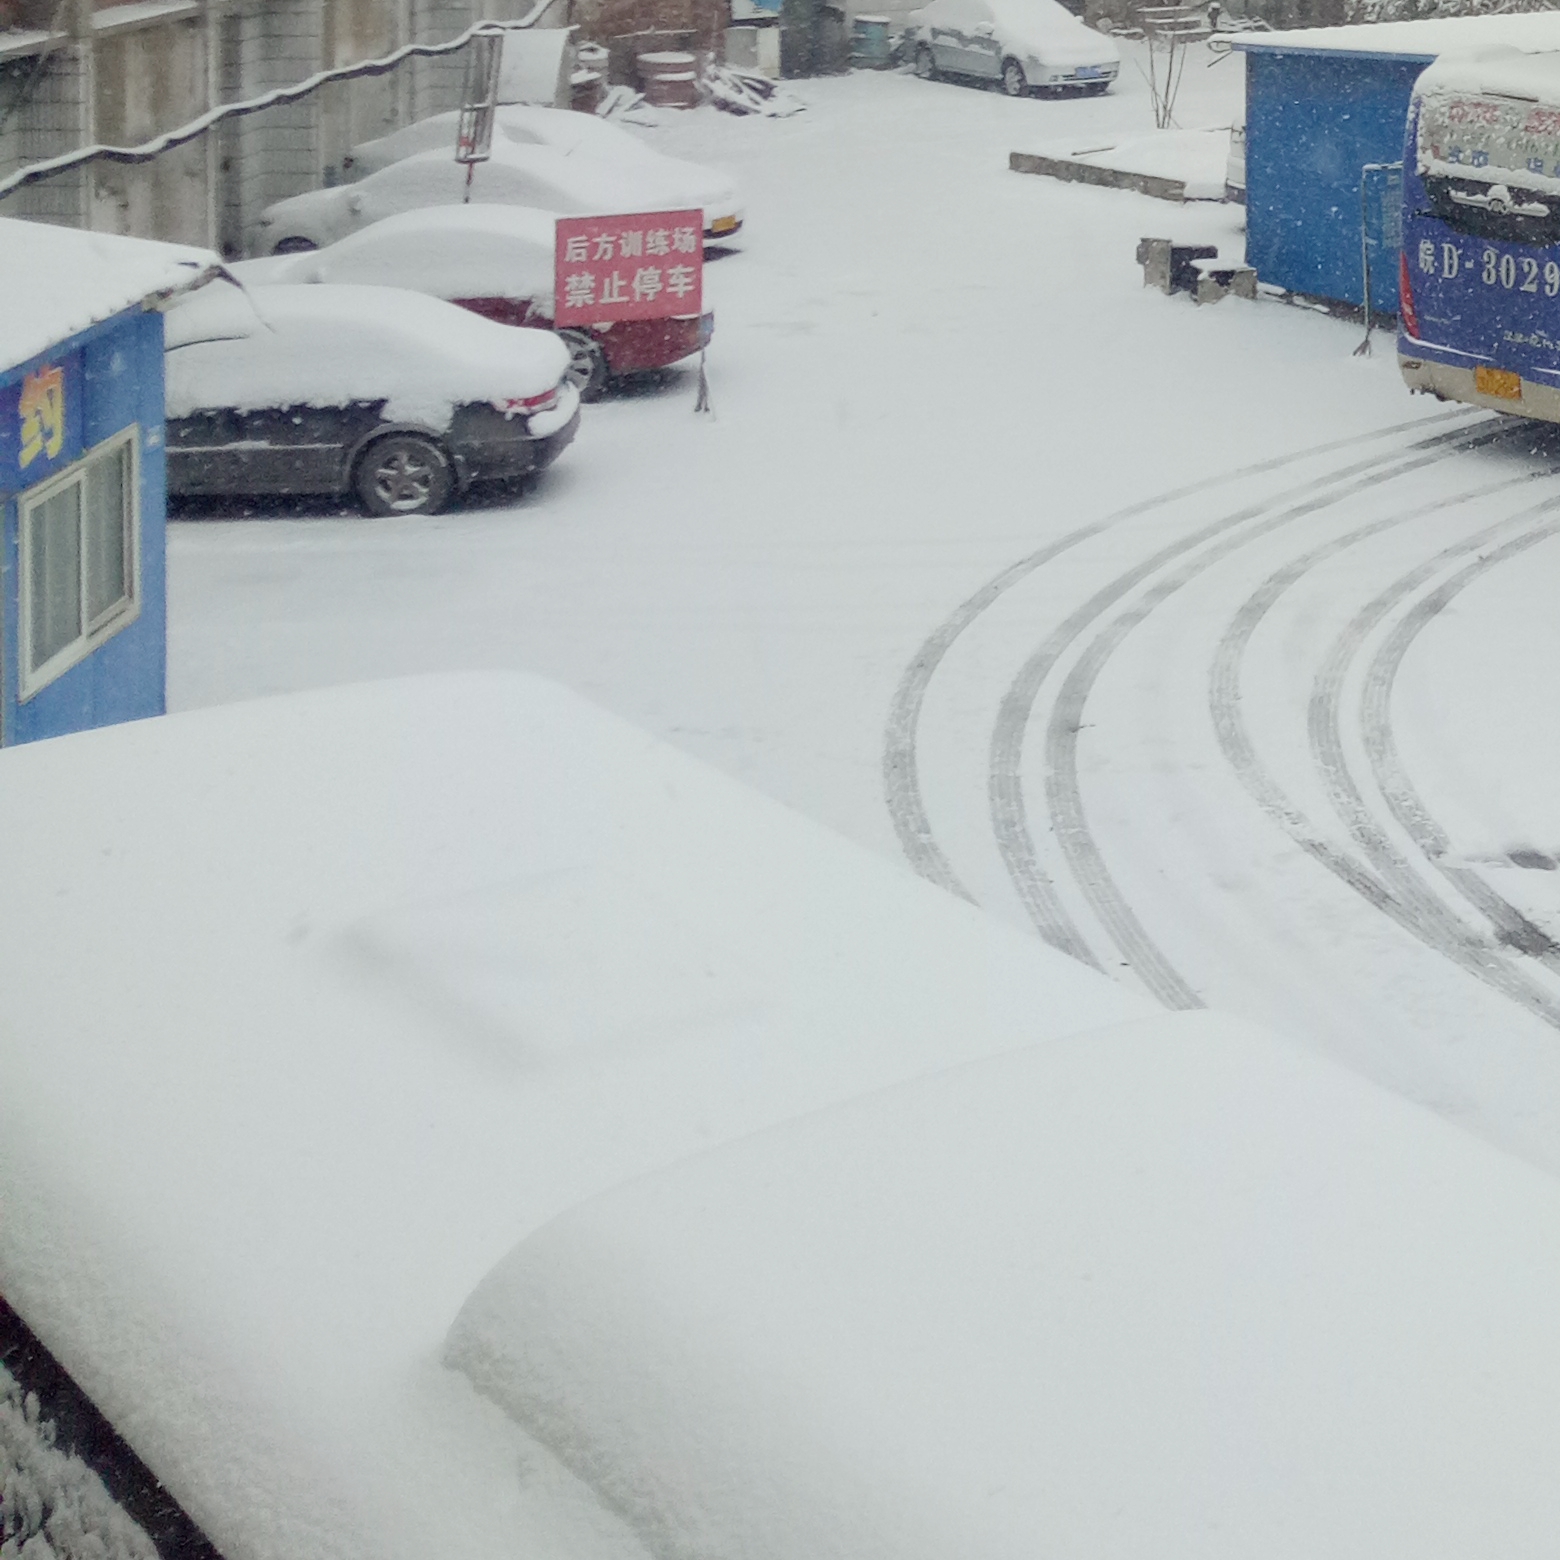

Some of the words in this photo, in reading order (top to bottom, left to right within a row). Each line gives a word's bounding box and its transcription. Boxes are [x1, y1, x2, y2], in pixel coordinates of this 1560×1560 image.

[564, 226, 697, 263] 后方训练场
[564, 264, 696, 308] 禁止停车
